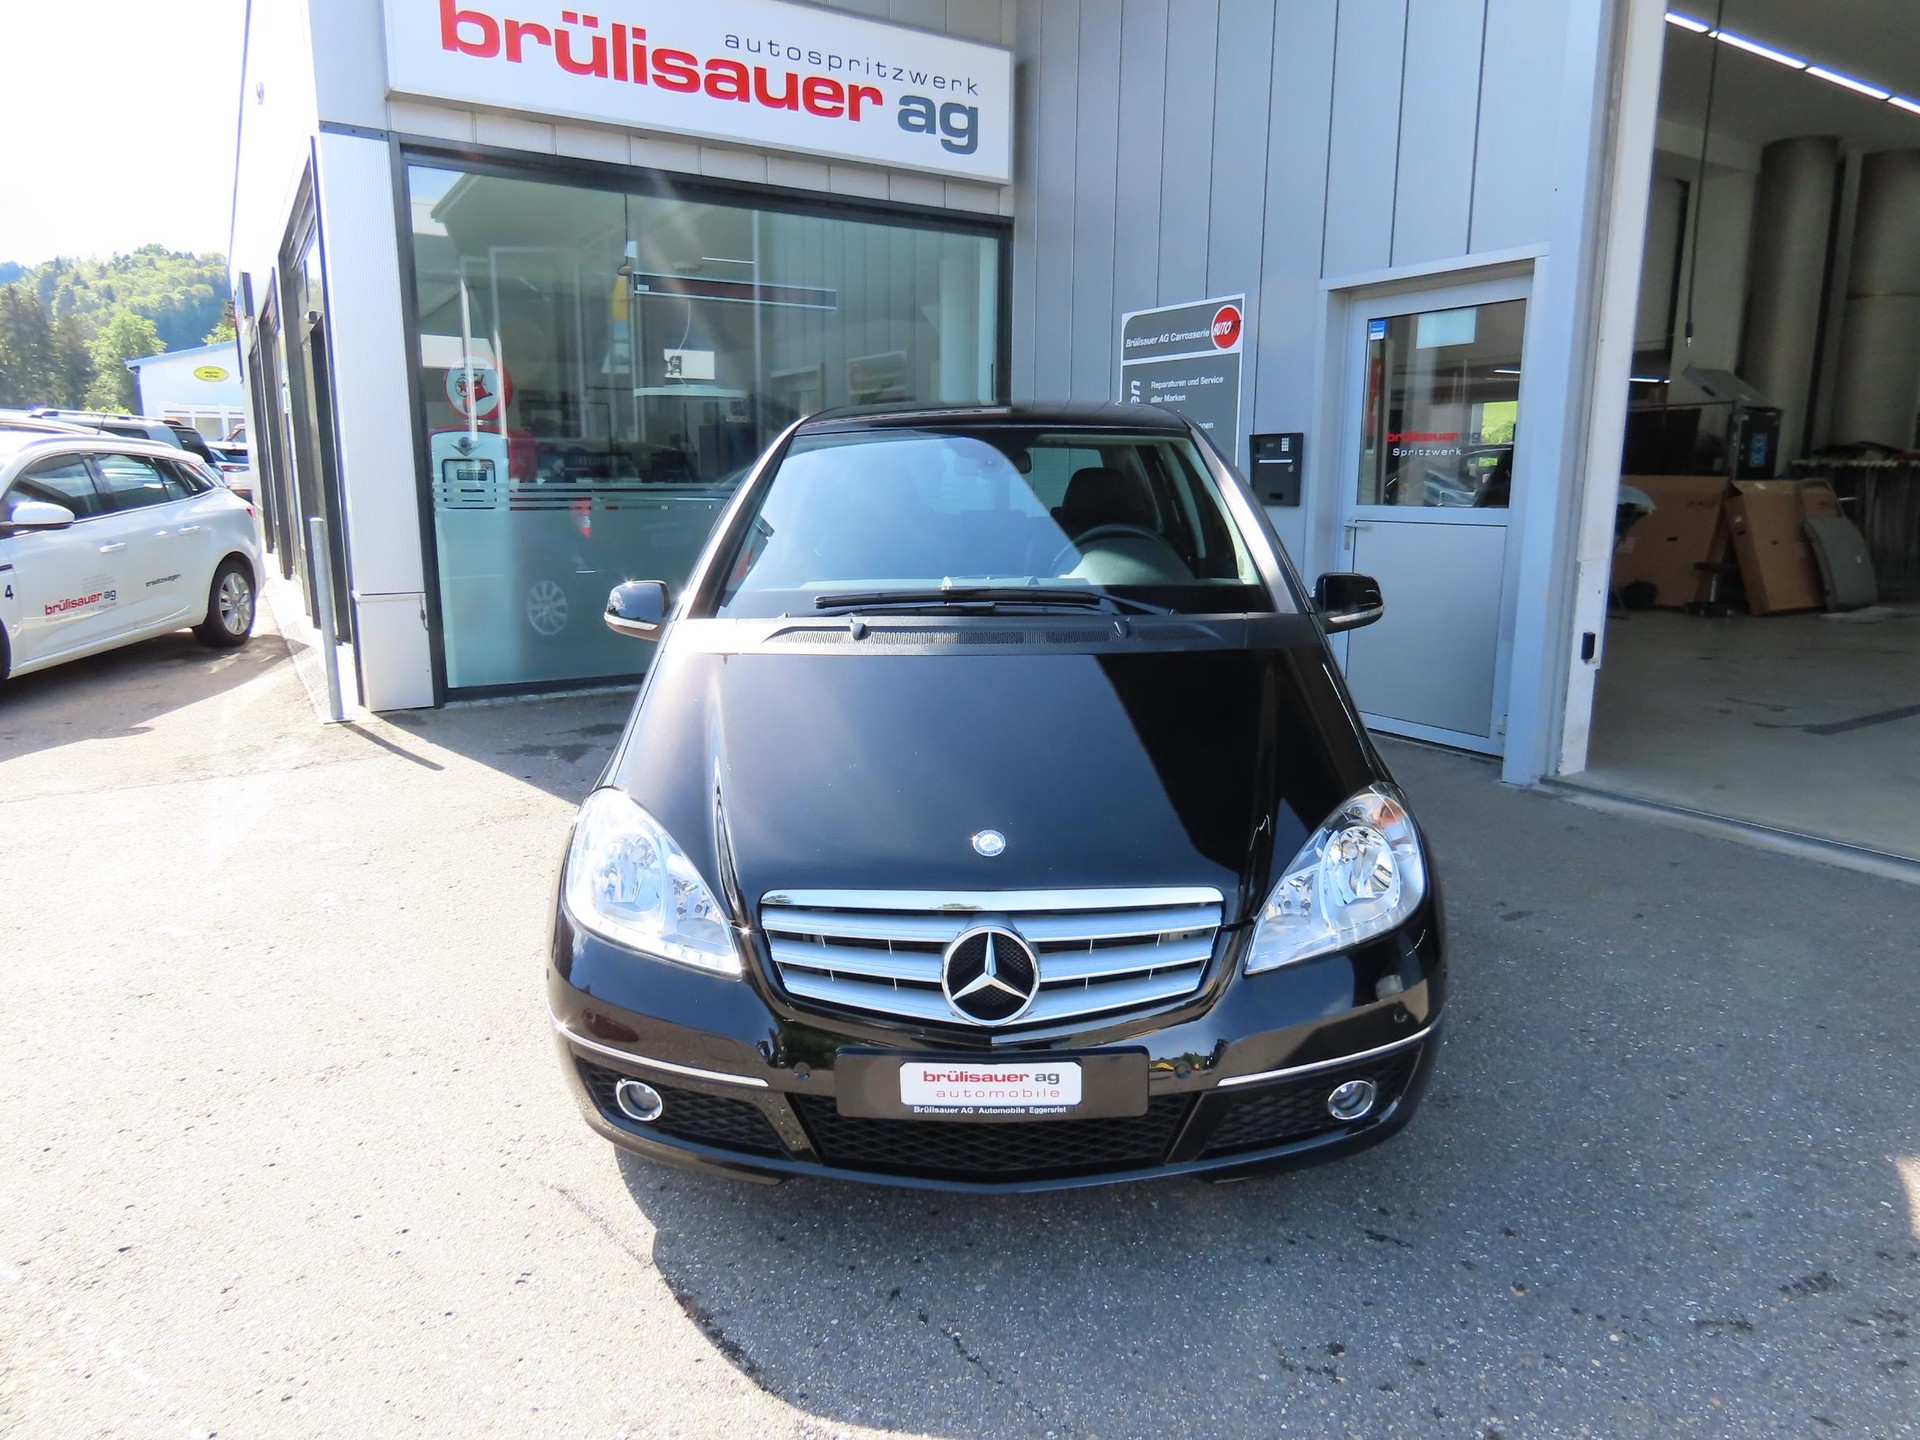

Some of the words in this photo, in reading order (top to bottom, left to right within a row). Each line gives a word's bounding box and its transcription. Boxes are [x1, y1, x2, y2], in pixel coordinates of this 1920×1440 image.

[724, 33, 979, 96] autospritzwerk
[440, 0, 884, 122] brülisauer
[897, 94, 980, 155] ag
[1125, 336, 1158, 348] Brülisauer
[1158, 333, 1170, 344] AG
[1170, 328, 1210, 342] Carrosserie
[1150, 380, 1187, 390] Reparaturen
[1187, 377, 1200, 386] und
[1200, 375, 1224, 385] Service
[1150, 395, 1163, 404] aller
[1163, 394, 1186, 403] Marken
[1392, 447, 1462, 458] Spritzwerk
[4, 584, 14, 600] 4
[44, 591, 103, 616] brülisauer
[103, 589, 117, 601] ag
[923, 1070, 1030, 1083] brülisauer
[1034, 1071, 1060, 1085] ag
[935, 1087, 1060, 1099] automobile
[913, 1105, 959, 1115] Brülisauer
[960, 1106, 974, 1115] AG
[978, 1106, 1026, 1115] Automobile
